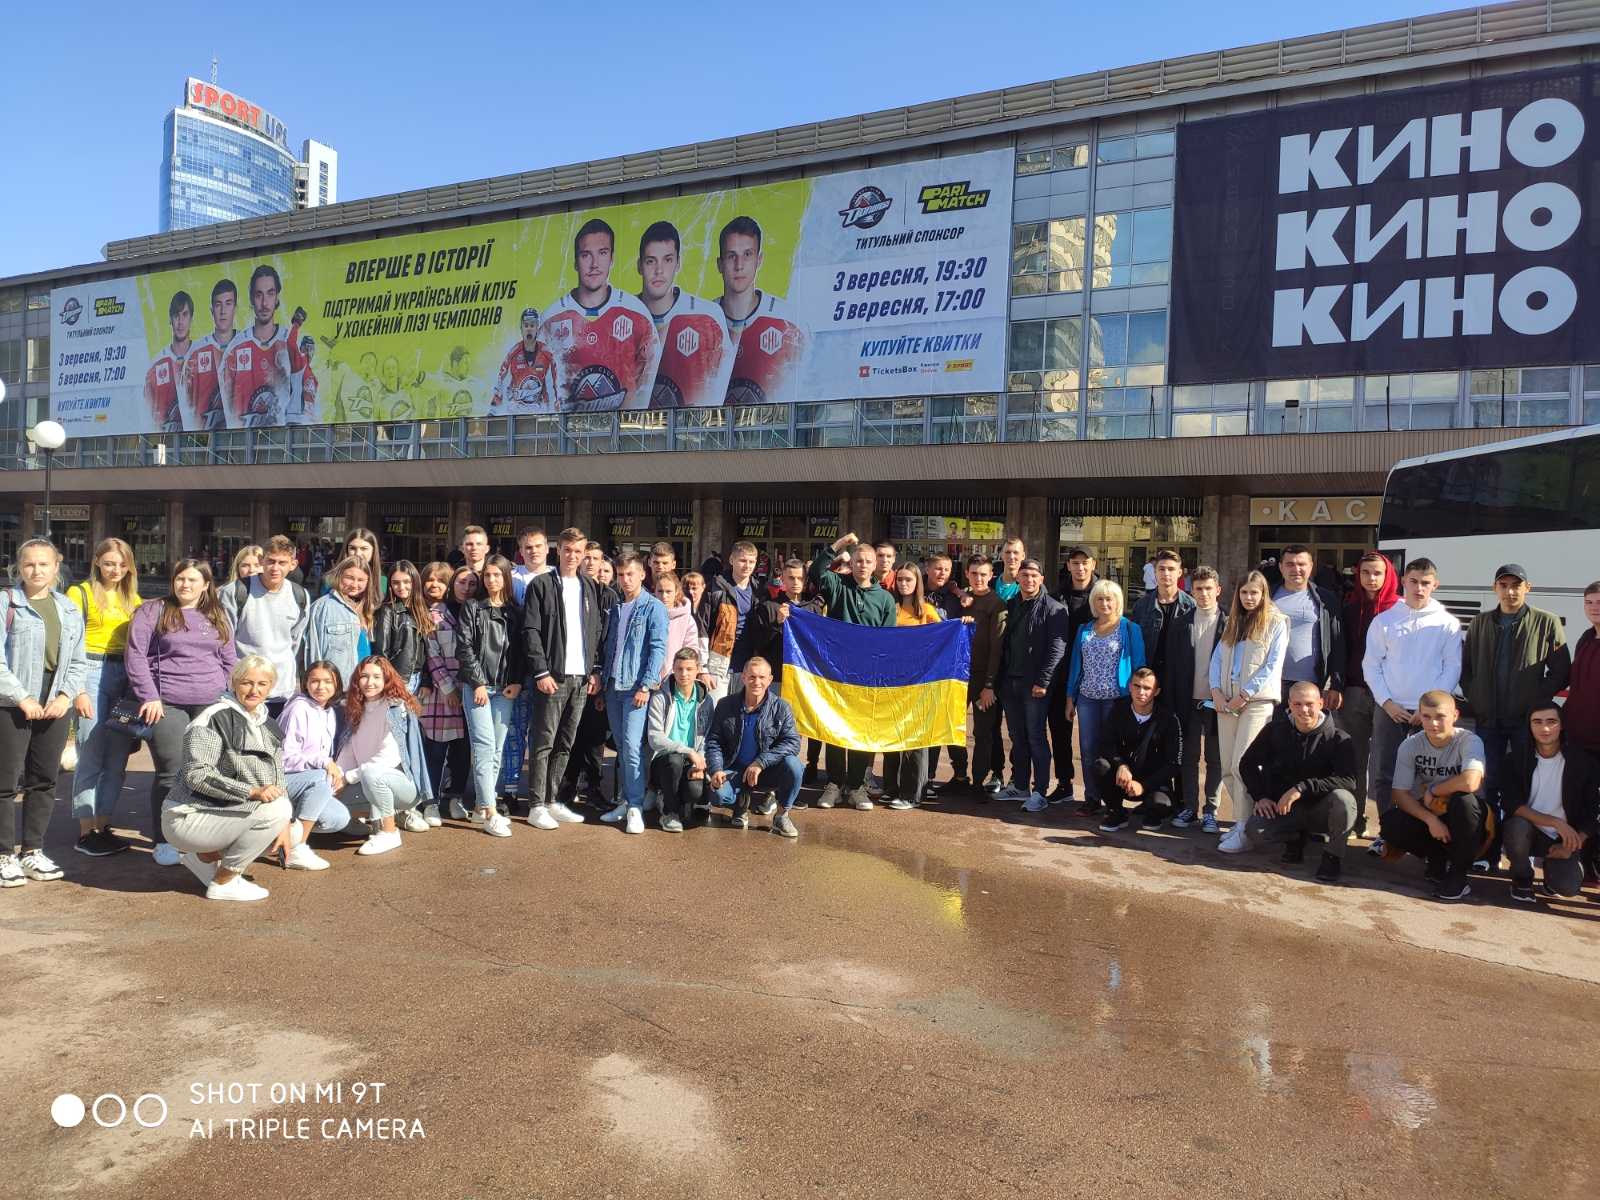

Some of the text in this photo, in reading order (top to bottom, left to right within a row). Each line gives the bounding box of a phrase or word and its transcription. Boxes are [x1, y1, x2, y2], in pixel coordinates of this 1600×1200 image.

[192, 82, 261, 129] SPORT
[1278, 98, 1585, 195] КИНО
[923, 184, 966, 200] PARI
[927, 193, 986, 211] MATCH
[856, 226, 965, 250] ТИТУЛЬНИЙ СПОНСОР
[1275, 181, 1582, 271] КИНО
[345, 238, 496, 284] ВПЕРШЕ В ІСТОРІЇ
[833, 256, 988, 293] 3 вересня, 19:30
[322, 279, 518, 319] ПІДТРИМАЙ УКРАЇНСЬКИЙ КЛУБ
[833, 287, 986, 322] 5 вересня, 17:00
[1272, 265, 1578, 347] КИНО
[335, 305, 503, 340] У ХОКЕЙНІЙ ЛІЗІ ЧЕМПІОНІВ
[58, 352, 65, 367] 3
[104, 345, 127, 363] 19:30
[860, 332, 983, 358] КУПУЙТЕ КВИТКИ
[57, 372, 65, 387] 5
[104, 365, 126, 382] 17:00
[872, 364, 917, 376] TicketsBox
